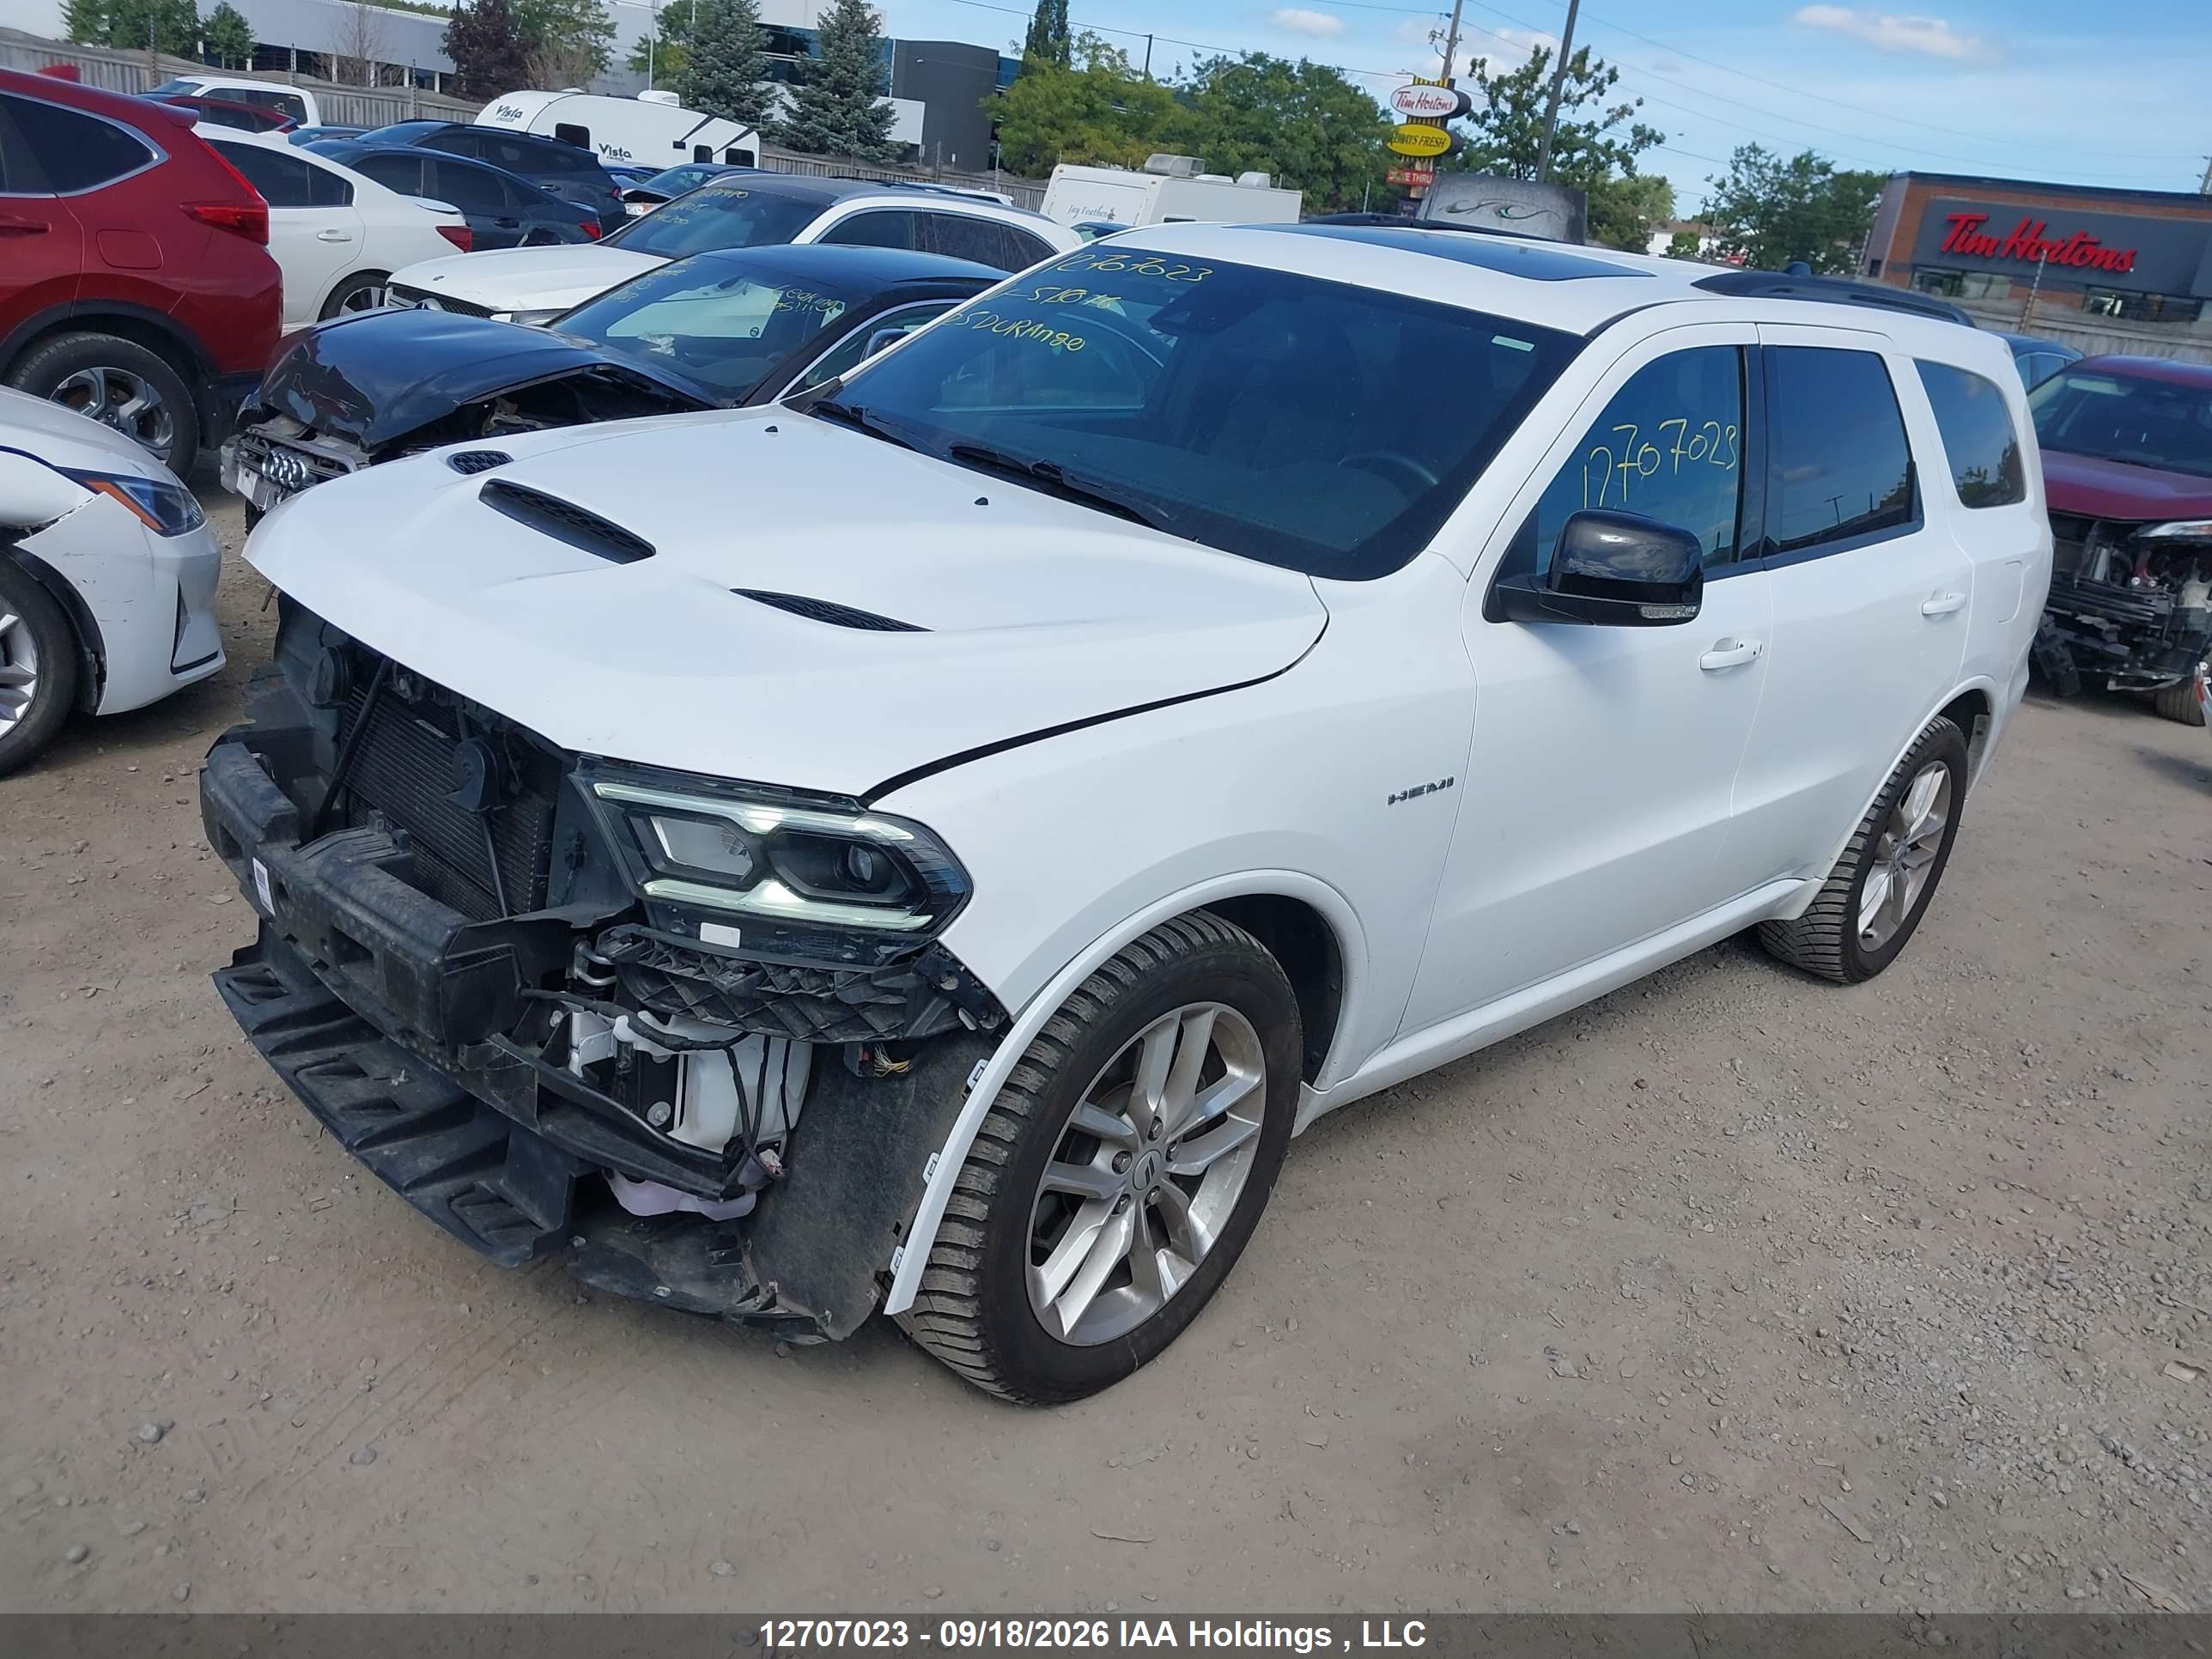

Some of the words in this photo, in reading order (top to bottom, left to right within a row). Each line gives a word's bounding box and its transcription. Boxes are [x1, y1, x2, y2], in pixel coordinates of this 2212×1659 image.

[1396, 91, 1414, 109] Tim
[1415, 92, 1453, 111] Hortons
[495, 105, 523, 118] Vista
[1419, 135, 1447, 149] FRESH
[599, 143, 632, 159] Vista
[1412, 173, 1433, 184] THRU
[1082, 205, 1108, 217] Feather
[1942, 214, 2000, 258] Tim
[2000, 216, 2138, 272] Hortons
[1388, 776, 1455, 805] HEMI
